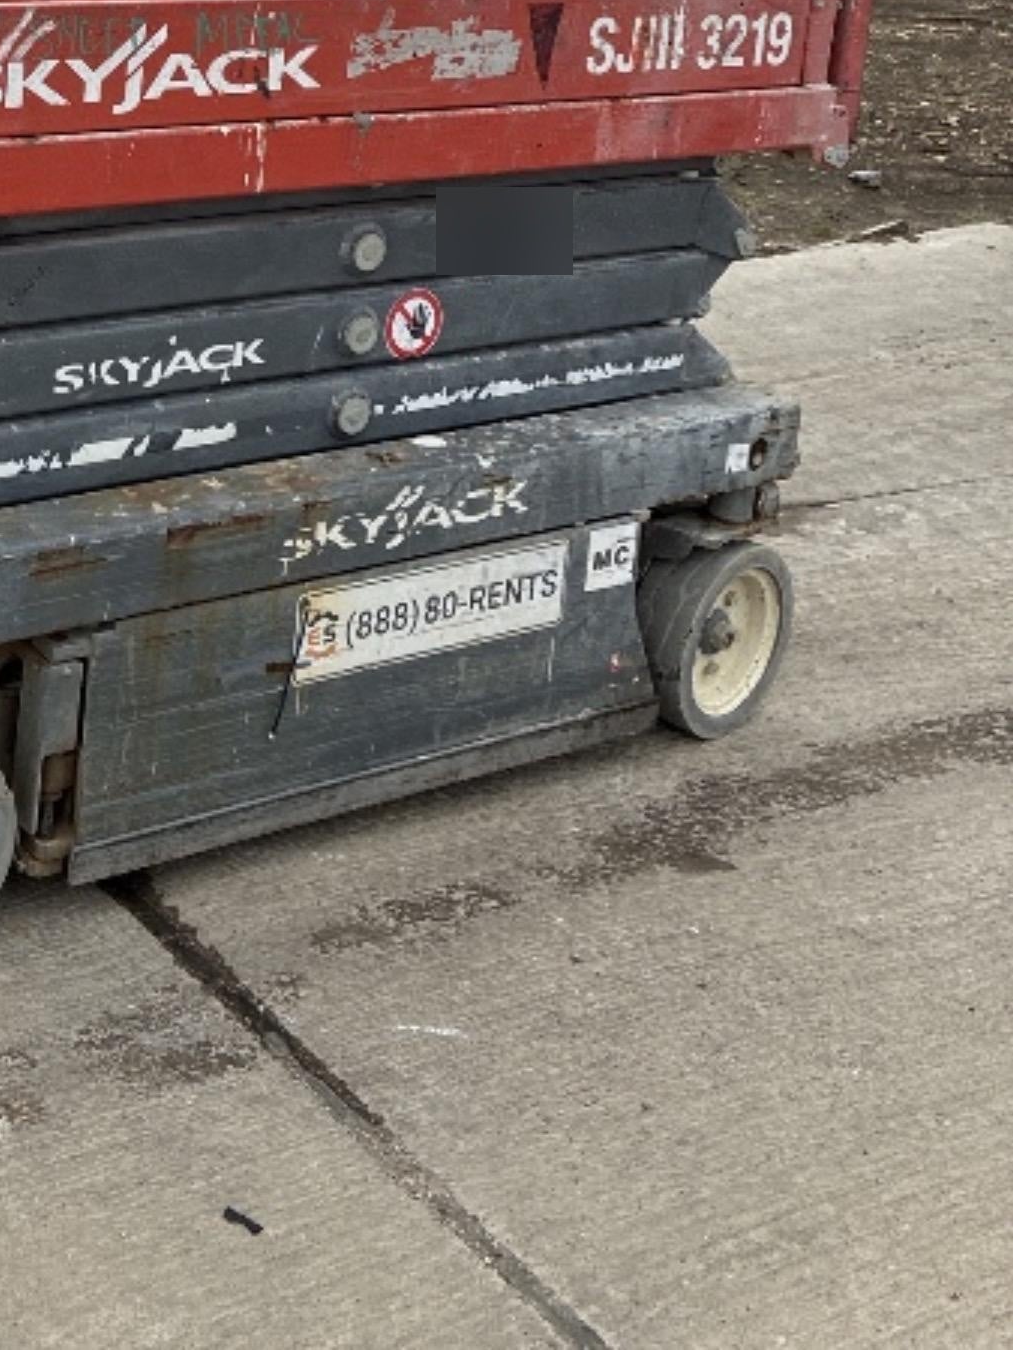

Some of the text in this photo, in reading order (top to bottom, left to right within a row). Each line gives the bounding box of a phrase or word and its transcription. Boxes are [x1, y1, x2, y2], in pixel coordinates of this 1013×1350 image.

[697, 11, 793, 71] 3219
[52, 337, 267, 395] SKYJACK
[592, 544, 630, 571] MC
